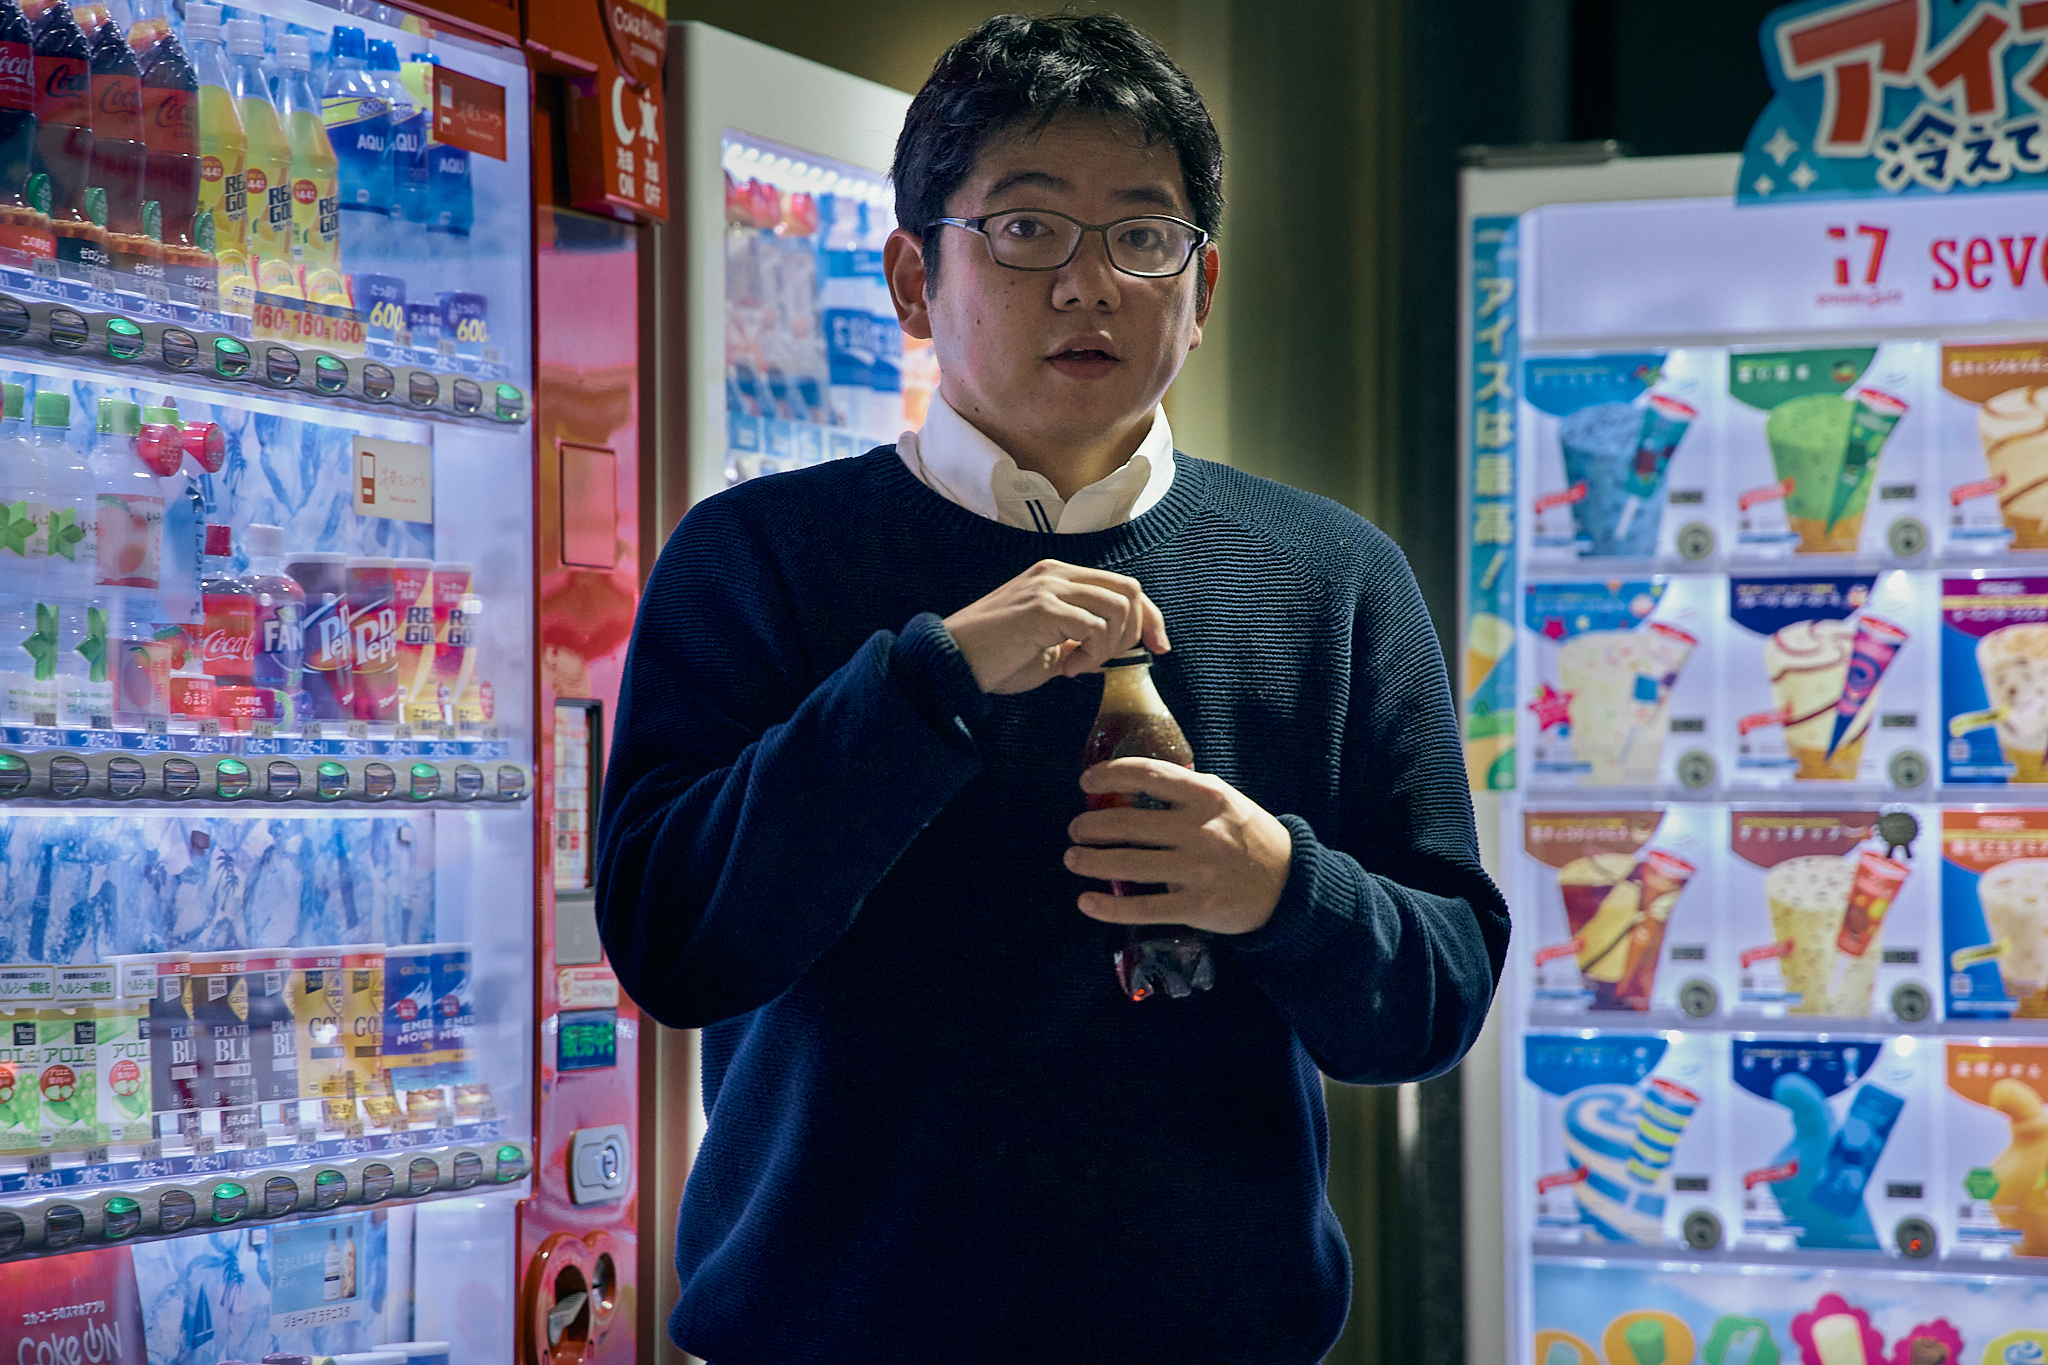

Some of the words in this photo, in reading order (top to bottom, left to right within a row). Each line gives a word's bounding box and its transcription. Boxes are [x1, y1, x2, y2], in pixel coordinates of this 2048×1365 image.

[1880, 112, 2044, 184] 冷えて
[17, 1332, 83, 1365] Coke
[83, 1317, 124, 1364] ON
